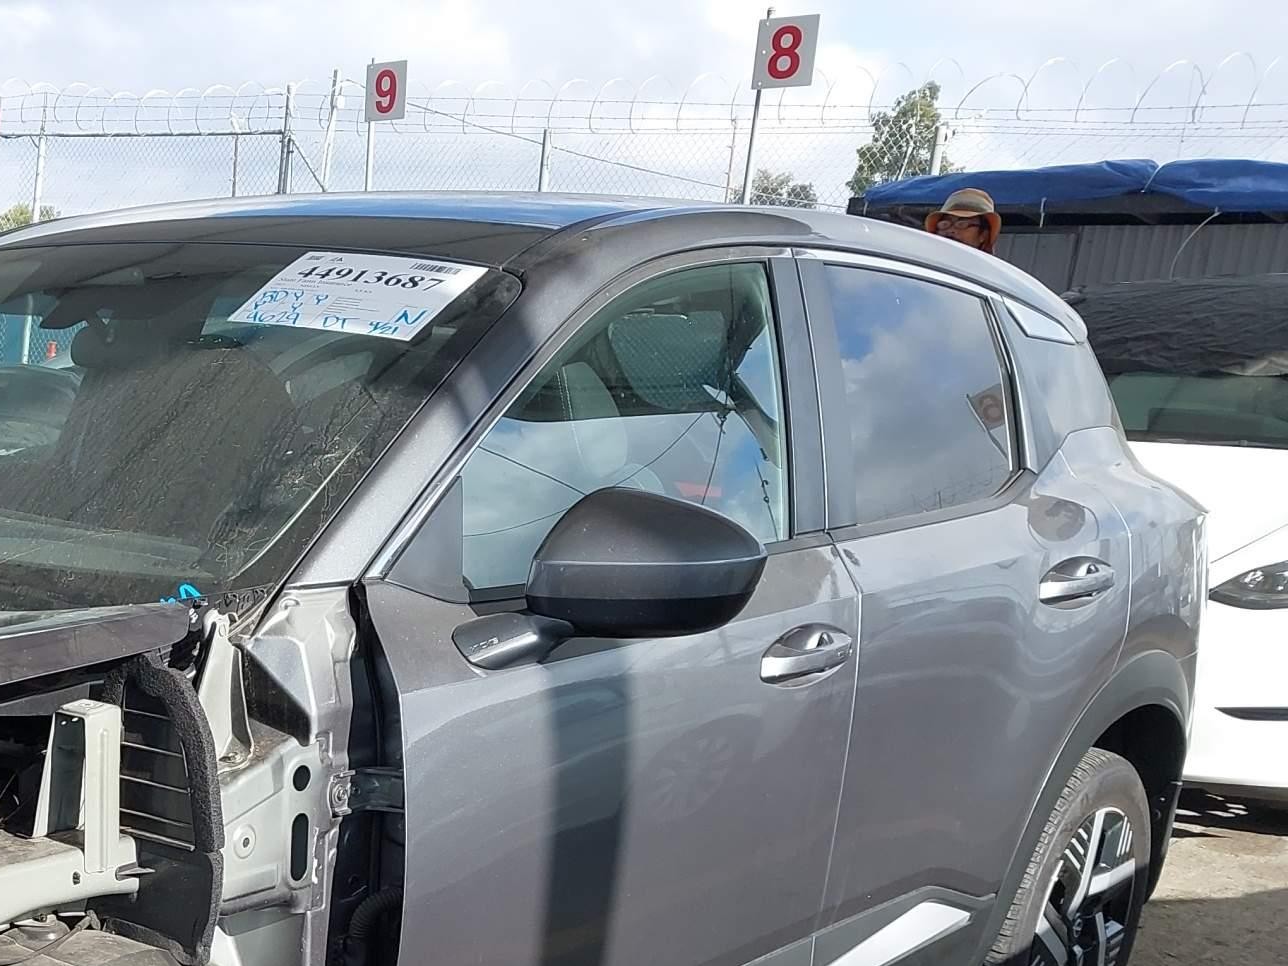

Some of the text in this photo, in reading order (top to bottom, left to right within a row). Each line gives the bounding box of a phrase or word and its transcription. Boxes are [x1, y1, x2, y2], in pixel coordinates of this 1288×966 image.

[767, 25, 803, 80] 8
[375, 69, 397, 114] 9
[297, 265, 446, 292] 44913687
[394, 309, 429, 325] N
